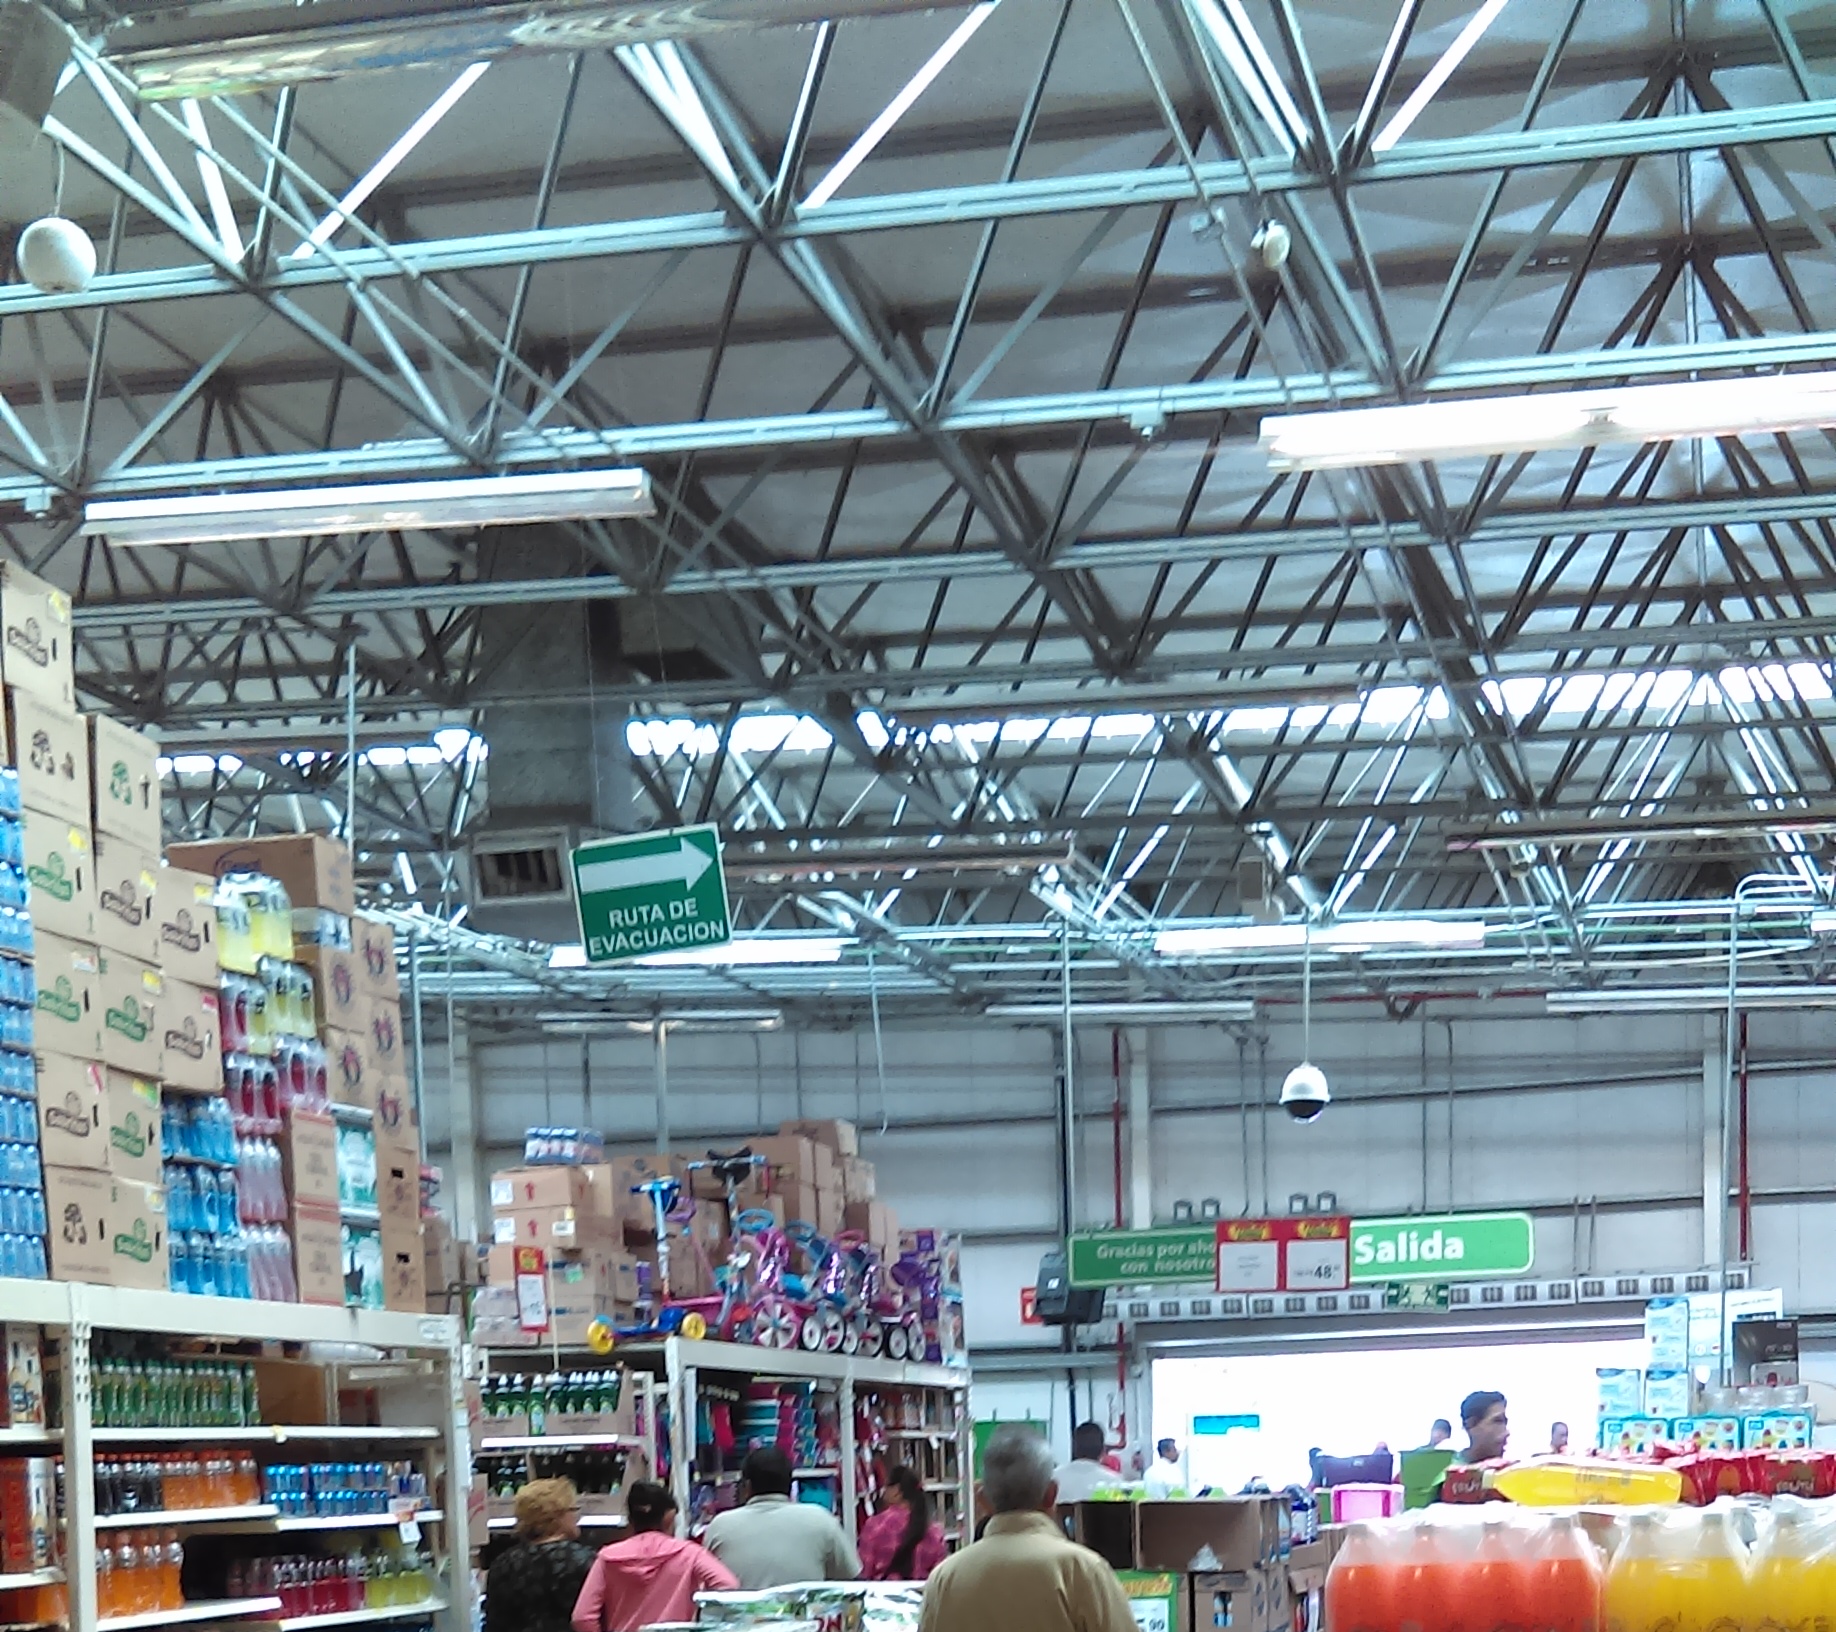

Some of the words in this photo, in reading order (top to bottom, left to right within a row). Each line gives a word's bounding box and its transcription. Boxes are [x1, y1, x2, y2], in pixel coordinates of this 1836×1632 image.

[608, 903, 665, 929] RUTA
[669, 897, 699, 920] DE
[588, 919, 725, 956] EVACUACION
[1097, 1242, 1155, 1259] Gracias
[1157, 1243, 1185, 1259] por
[1354, 1229, 1464, 1266] Salida
[1121, 1261, 1149, 1274] con
